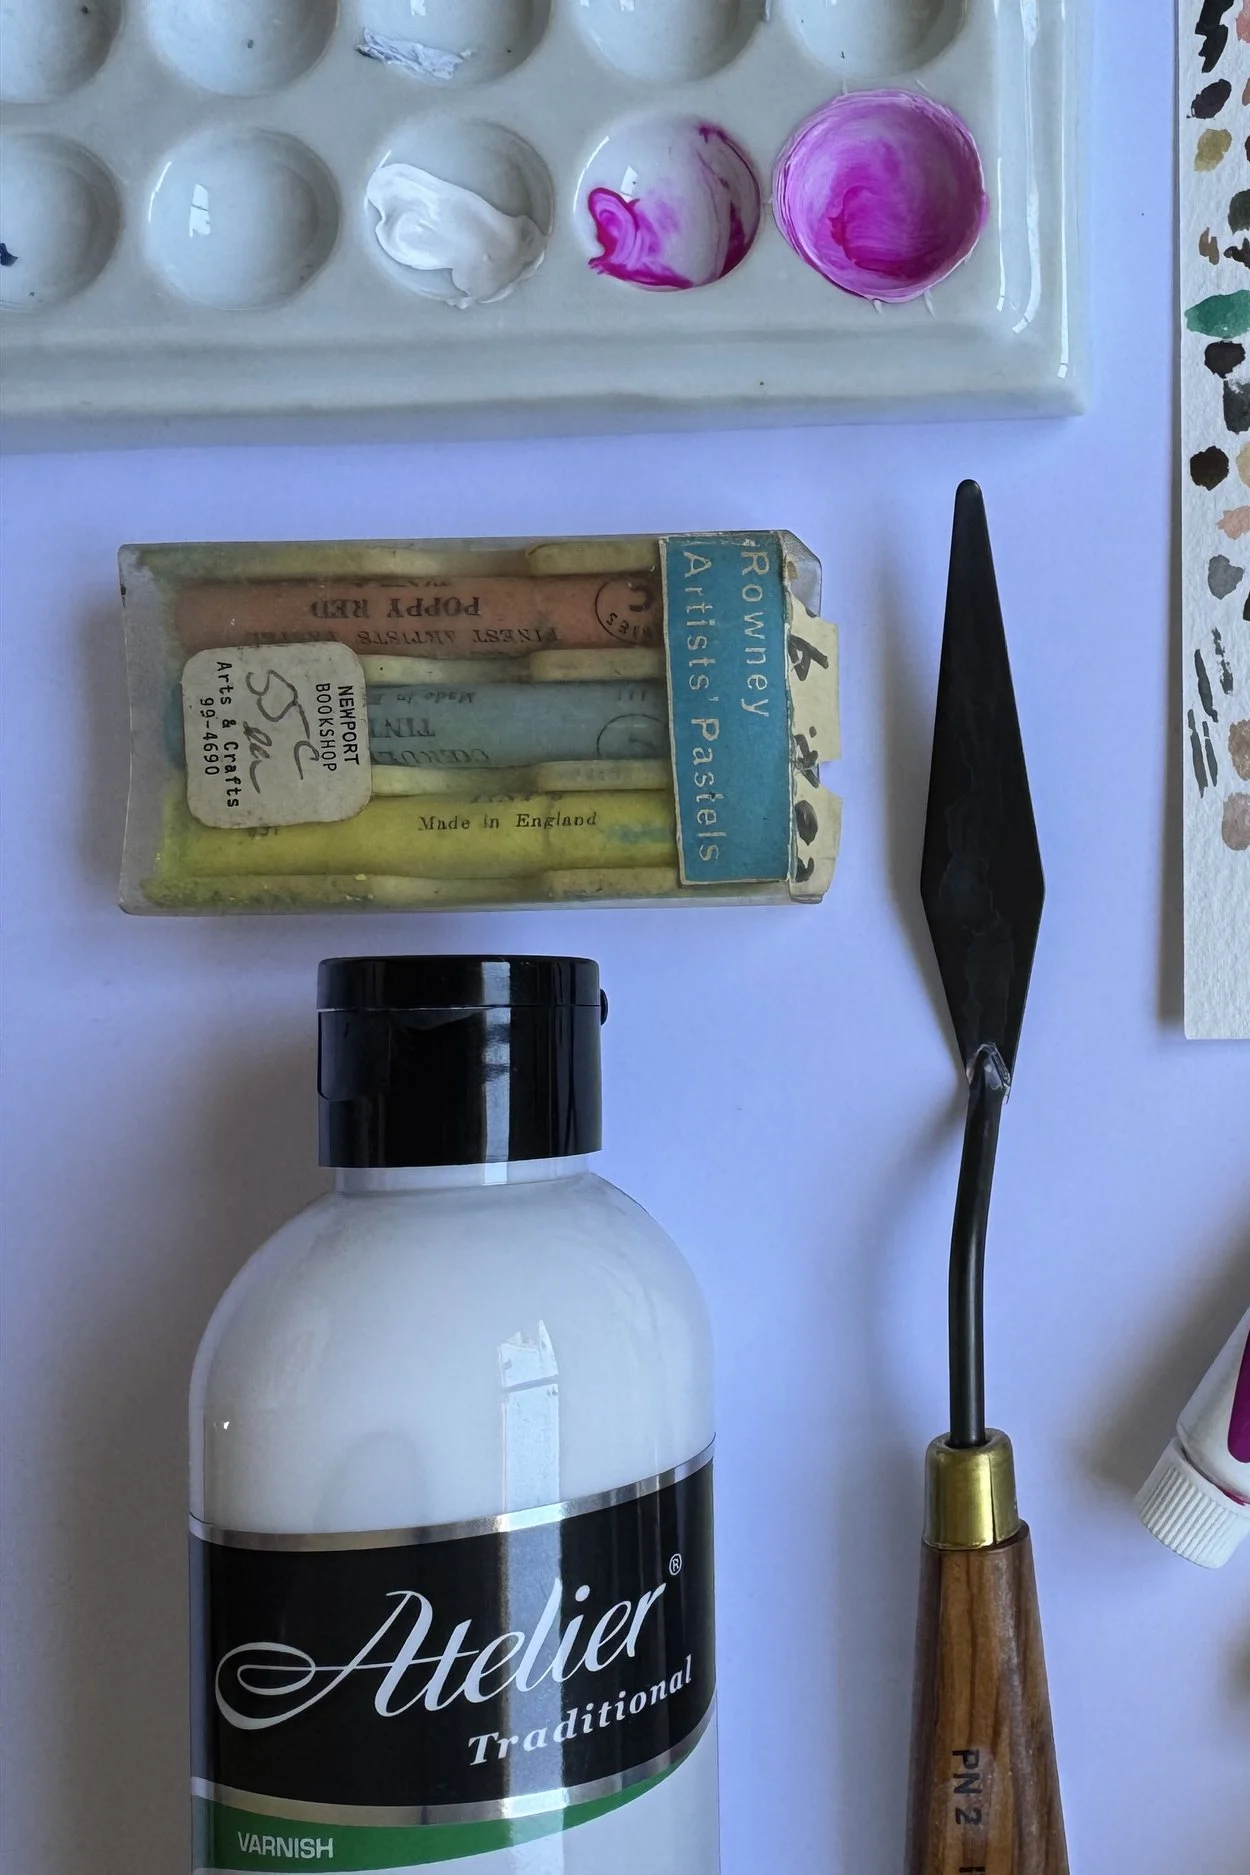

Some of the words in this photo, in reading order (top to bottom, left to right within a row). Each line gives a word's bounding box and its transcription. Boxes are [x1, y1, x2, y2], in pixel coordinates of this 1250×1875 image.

[387, 596, 481, 618] POPPY
[683, 550, 713, 703] Artists'
[742, 550, 771, 718] Rowney
[216, 660, 234, 705] Arts
[221, 718, 237, 729] &
[315, 682, 337, 772] BOOKSHOP
[337, 684, 360, 766] NEWPORT
[223, 740, 243, 808] Crafts
[691, 717, 727, 862] Pastels
[417, 816, 471, 832] Made
[483, 814, 500, 830] in
[515, 812, 597, 832] England
[214, 1577, 667, 1732] Atelier
[467, 1653, 693, 1766] Traditional
[236, 1830, 335, 1860] VARNISH
